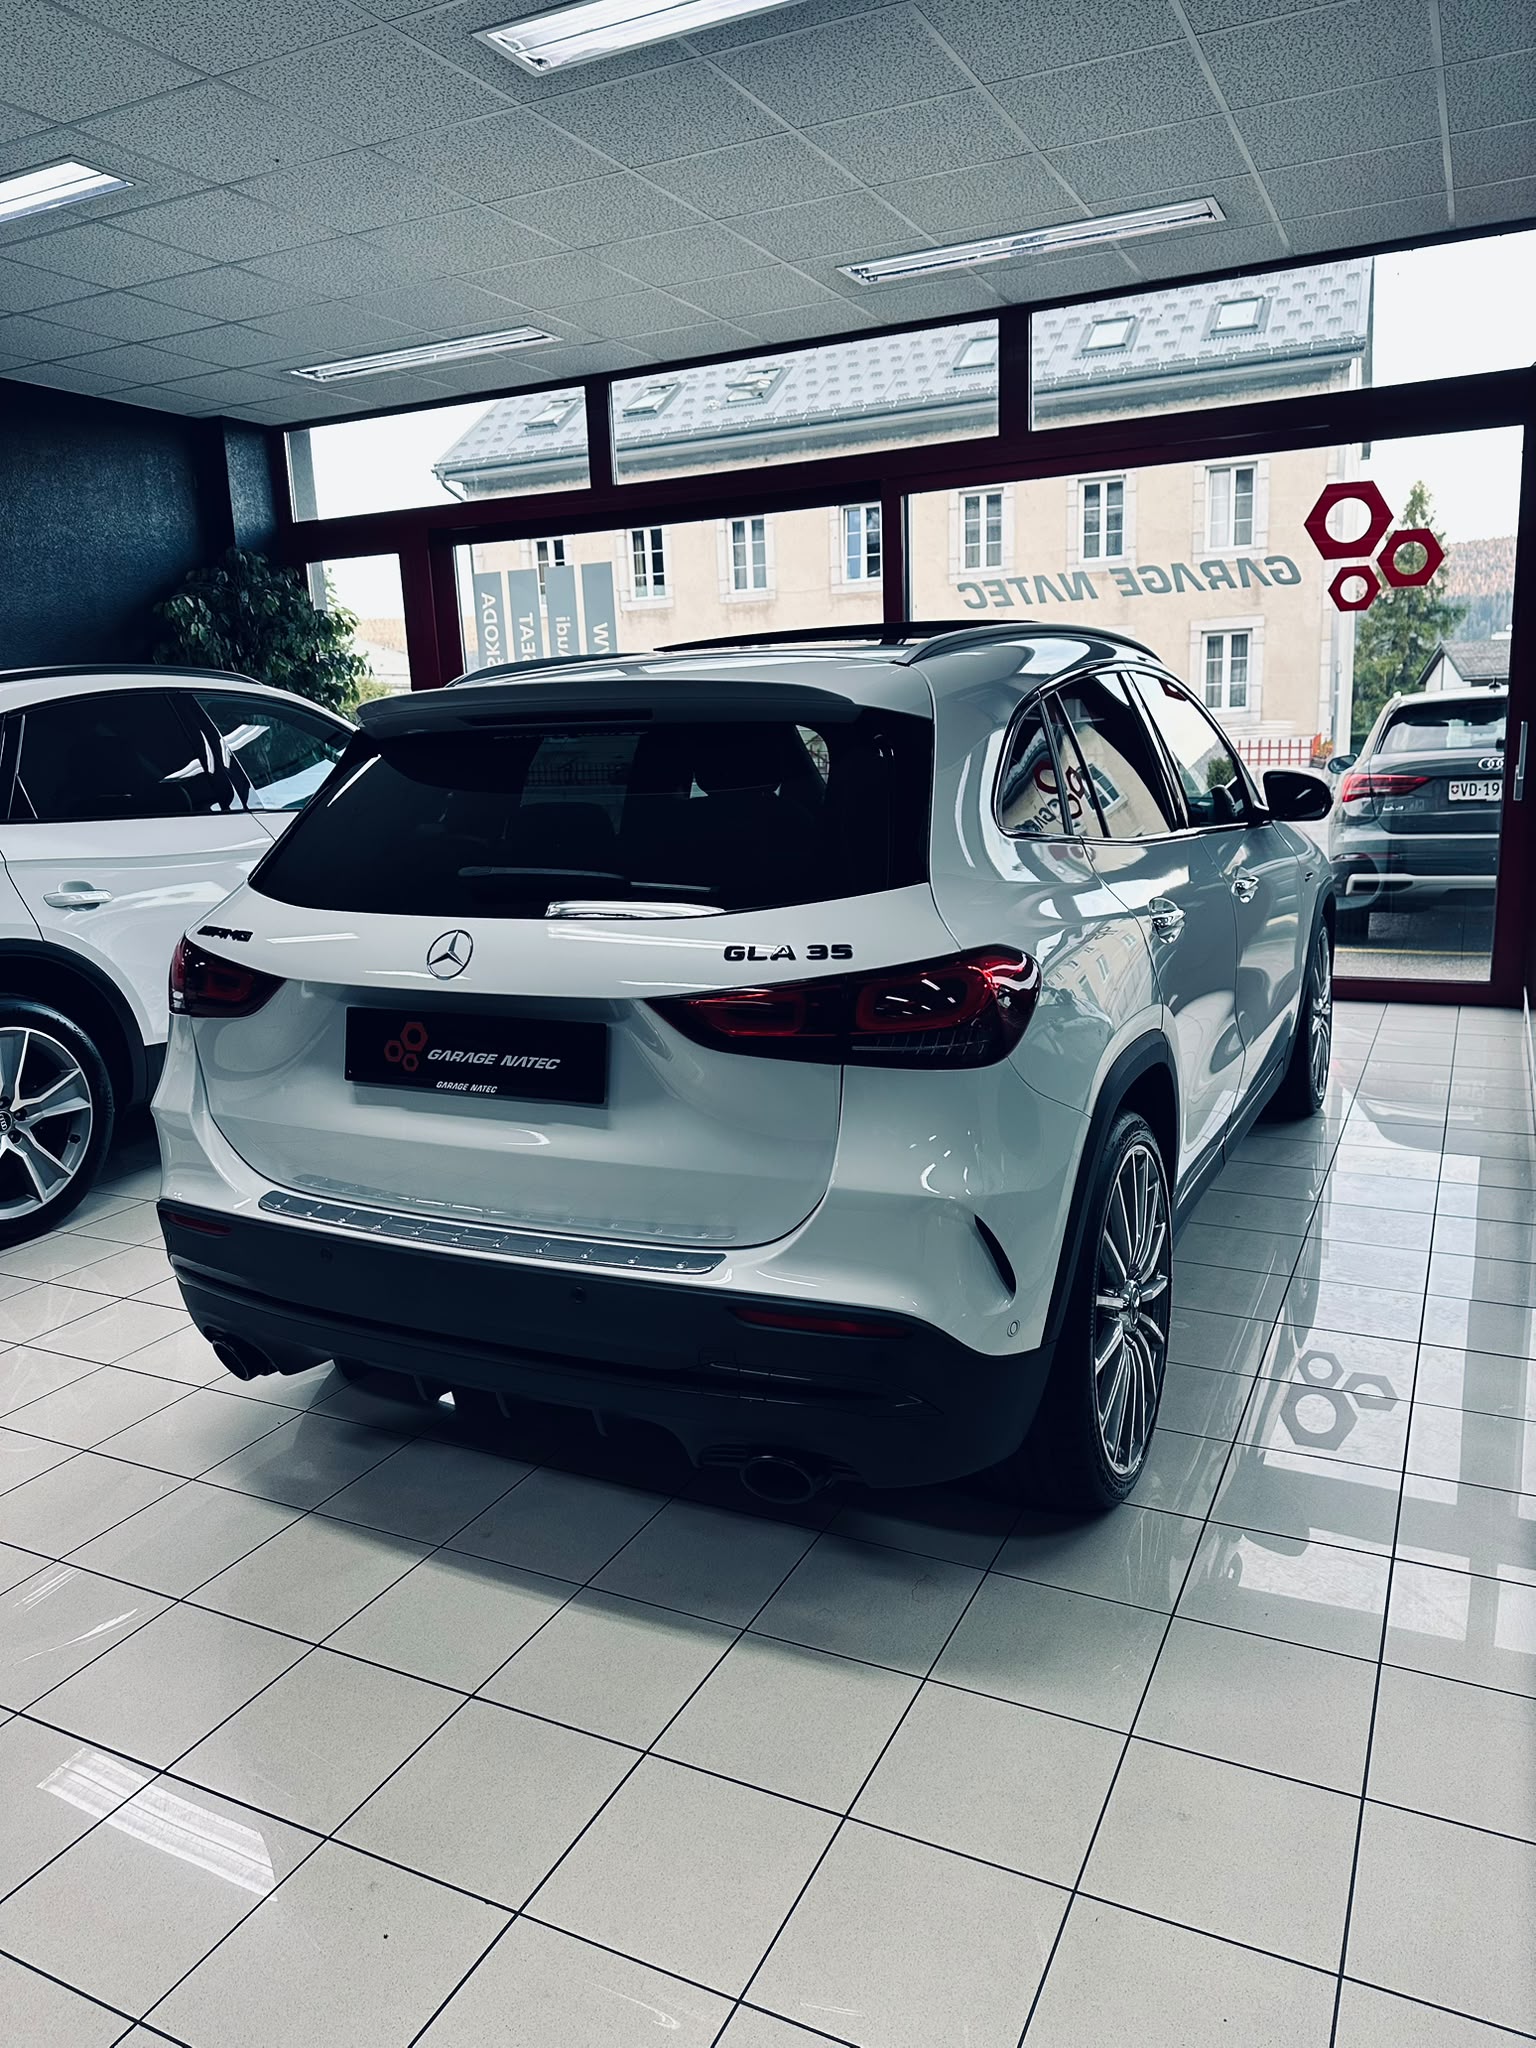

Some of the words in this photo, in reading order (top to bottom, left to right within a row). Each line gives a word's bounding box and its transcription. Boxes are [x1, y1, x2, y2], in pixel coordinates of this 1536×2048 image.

[724, 945, 796, 961] GLA
[806, 944, 853, 961] 35
[427, 1049, 498, 1065] GARAGE
[500, 1055, 561, 1070] NATEC
[436, 1081, 469, 1092] GARAGE
[470, 1083, 498, 1093] NATEC
